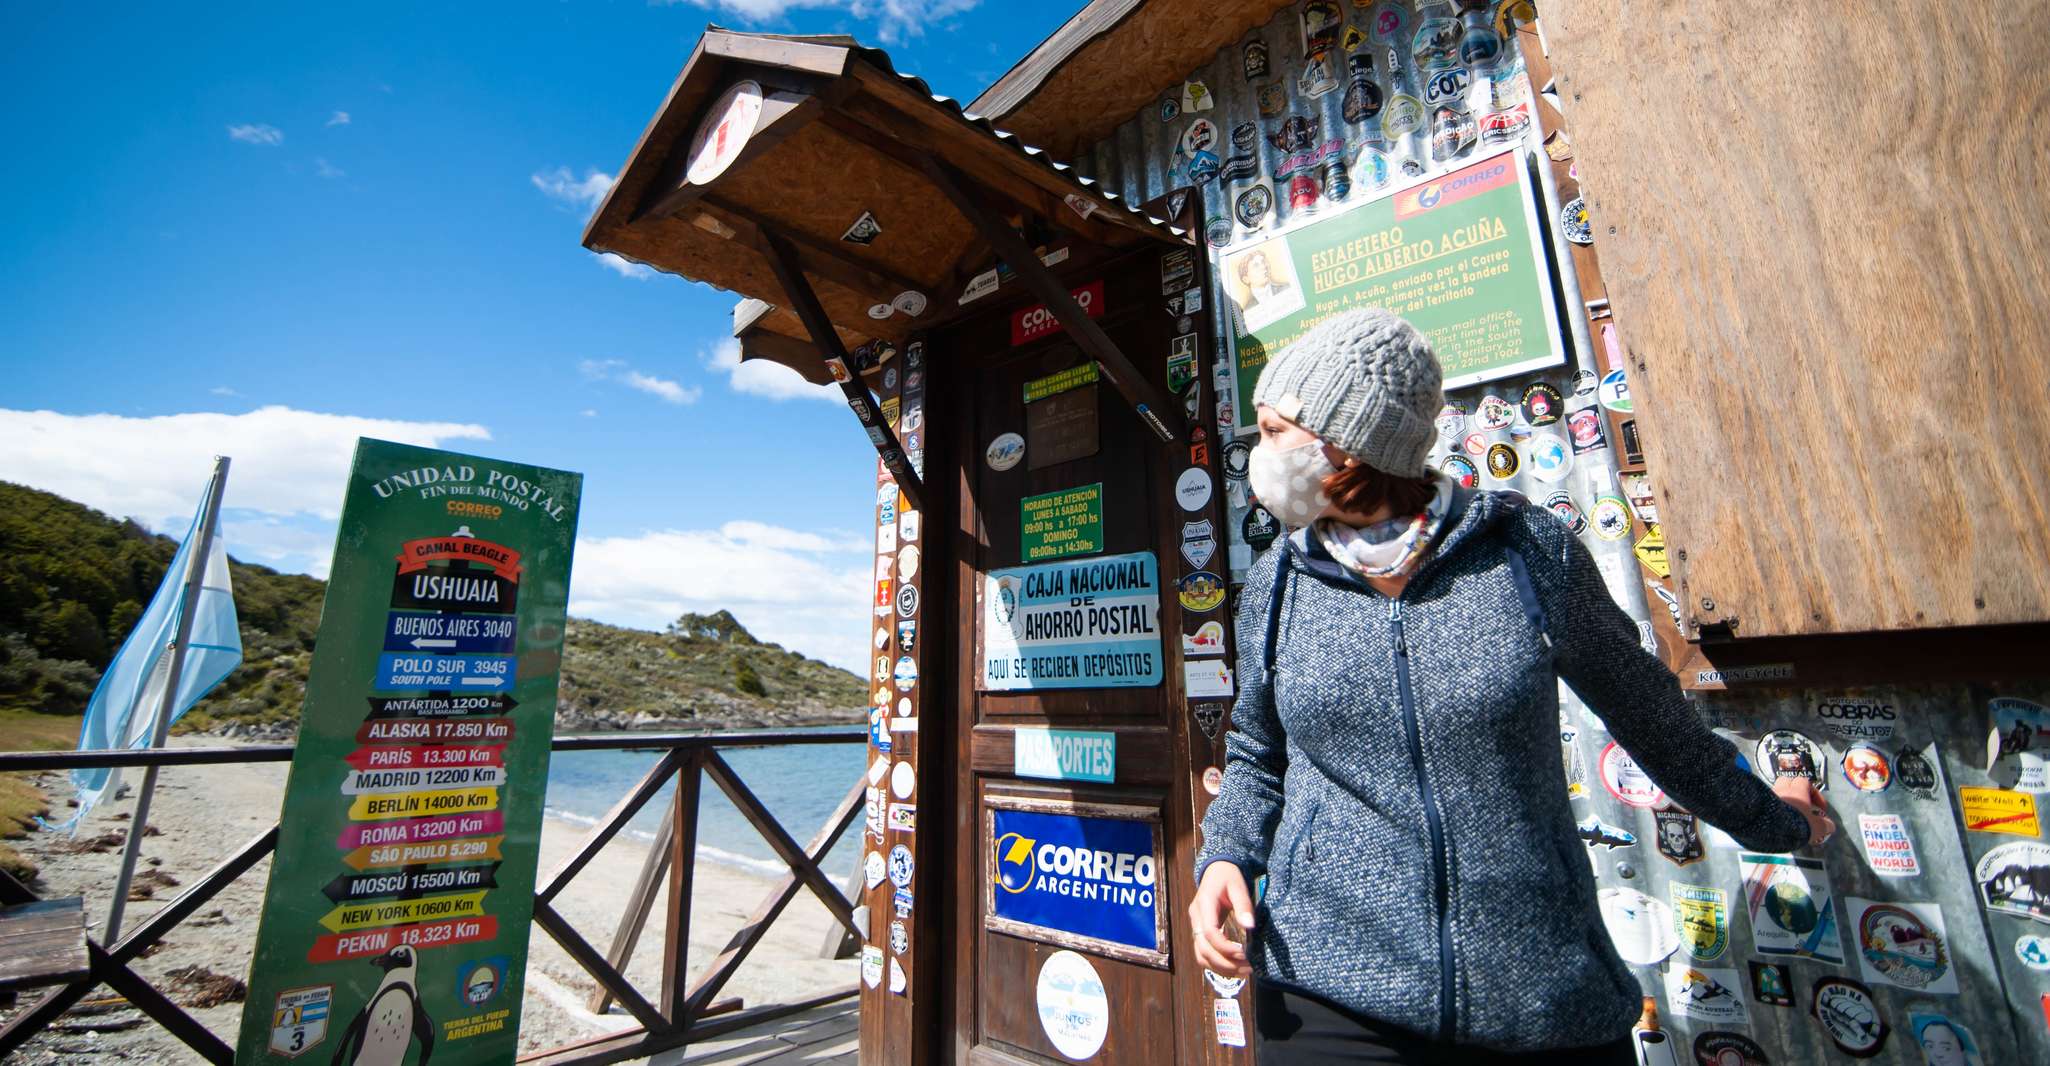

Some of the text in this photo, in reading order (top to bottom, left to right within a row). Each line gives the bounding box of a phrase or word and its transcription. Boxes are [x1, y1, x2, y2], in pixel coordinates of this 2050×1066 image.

[1429, 70, 1469, 101] COL
[1442, 164, 1506, 194] CORREO
[1312, 226, 1404, 269] ESTAFETERO
[1314, 216, 1507, 290] HUGO ALBERTO ACUÑA
[1316, 299, 1339, 313] Hugo
[1392, 270, 1433, 290] enviado
[1437, 265, 1455, 278] por
[1458, 259, 1469, 272] el
[1471, 249, 1510, 268] Correo
[1386, 287, 1424, 306] primera
[1428, 281, 1446, 292] vez
[1448, 276, 1459, 287] la
[1463, 262, 1509, 284] Bandera
[1407, 299, 1424, 312] del
[1426, 286, 1475, 307] Territorio
[1438, 333, 1457, 345] first
[1461, 325, 1485, 339] time
[1489, 322, 1500, 332] in
[1504, 315, 1522, 327] the
[1452, 320, 1476, 332] mail
[1466, 335, 1485, 348] the
[1488, 329, 1521, 342] South
[1507, 338, 1522, 347] on
[1462, 353, 1489, 367] 22nd
[373, 466, 564, 522] UNIDAD POSTAL
[421, 486, 530, 511] FIN DEL MUNDO
[1024, 489, 1097, 511] HORARIO DE ATENCIÓN
[447, 500, 503, 517] CORREO
[1033, 502, 1088, 520] LUNES A SABADO
[1024, 521, 1043, 534] 09:00
[1045, 520, 1053, 530] hs
[1068, 515, 1087, 527] 17:00
[1089, 513, 1098, 523] hs
[1044, 528, 1078, 543] DOMINGO
[416, 542, 509, 565] CANAL BEAGLE
[1030, 544, 1056, 558] 09:00hs
[1065, 539, 1094, 553] 14:30hs
[413, 575, 500, 603] USHUAIA
[1026, 560, 1150, 599] CAJA NACIONAL
[1070, 595, 1095, 608] DE
[394, 617, 512, 638] BUENOS AIRES 3040
[1025, 604, 1154, 640] AHORRO POSTAL
[393, 658, 507, 675] POLO SUR 3945
[988, 649, 1152, 681] AQUÍ SE RECIBEN DEPÓSITOS
[390, 675, 452, 685] SOUTH POLE
[384, 697, 449, 711] ANTÁRTIDA
[452, 698, 489, 709] 1200
[1818, 704, 1896, 721] COBRAS
[369, 723, 508, 738] ALASKA 17.850 Km
[370, 749, 490, 764] PARÍS 13.300 Km
[356, 767, 496, 789] MADRID 12200 Km
[367, 794, 488, 814] BERLÍN 14000 Km
[360, 819, 483, 845] ROMA 13200 Km
[1864, 830, 1907, 841] FIN DEL
[370, 842, 488, 864] SÃO PAULO 5.290
[1867, 841, 1910, 851] MUNDO
[1037, 844, 1156, 887] CORREO
[1872, 858, 1915, 868] WORLD
[351, 870, 480, 895] MOSCÚ 15500 Km
[1035, 875, 1153, 908] ARGENTINO
[341, 899, 474, 925] NEW YORK 10600 Km
[337, 923, 480, 955] PEKIN 18.323 Km
[444, 1009, 510, 1030] TIERRA DEL FUEGO
[447, 1019, 503, 1041] ARGENTINA
[290, 1031, 305, 1052] 3
